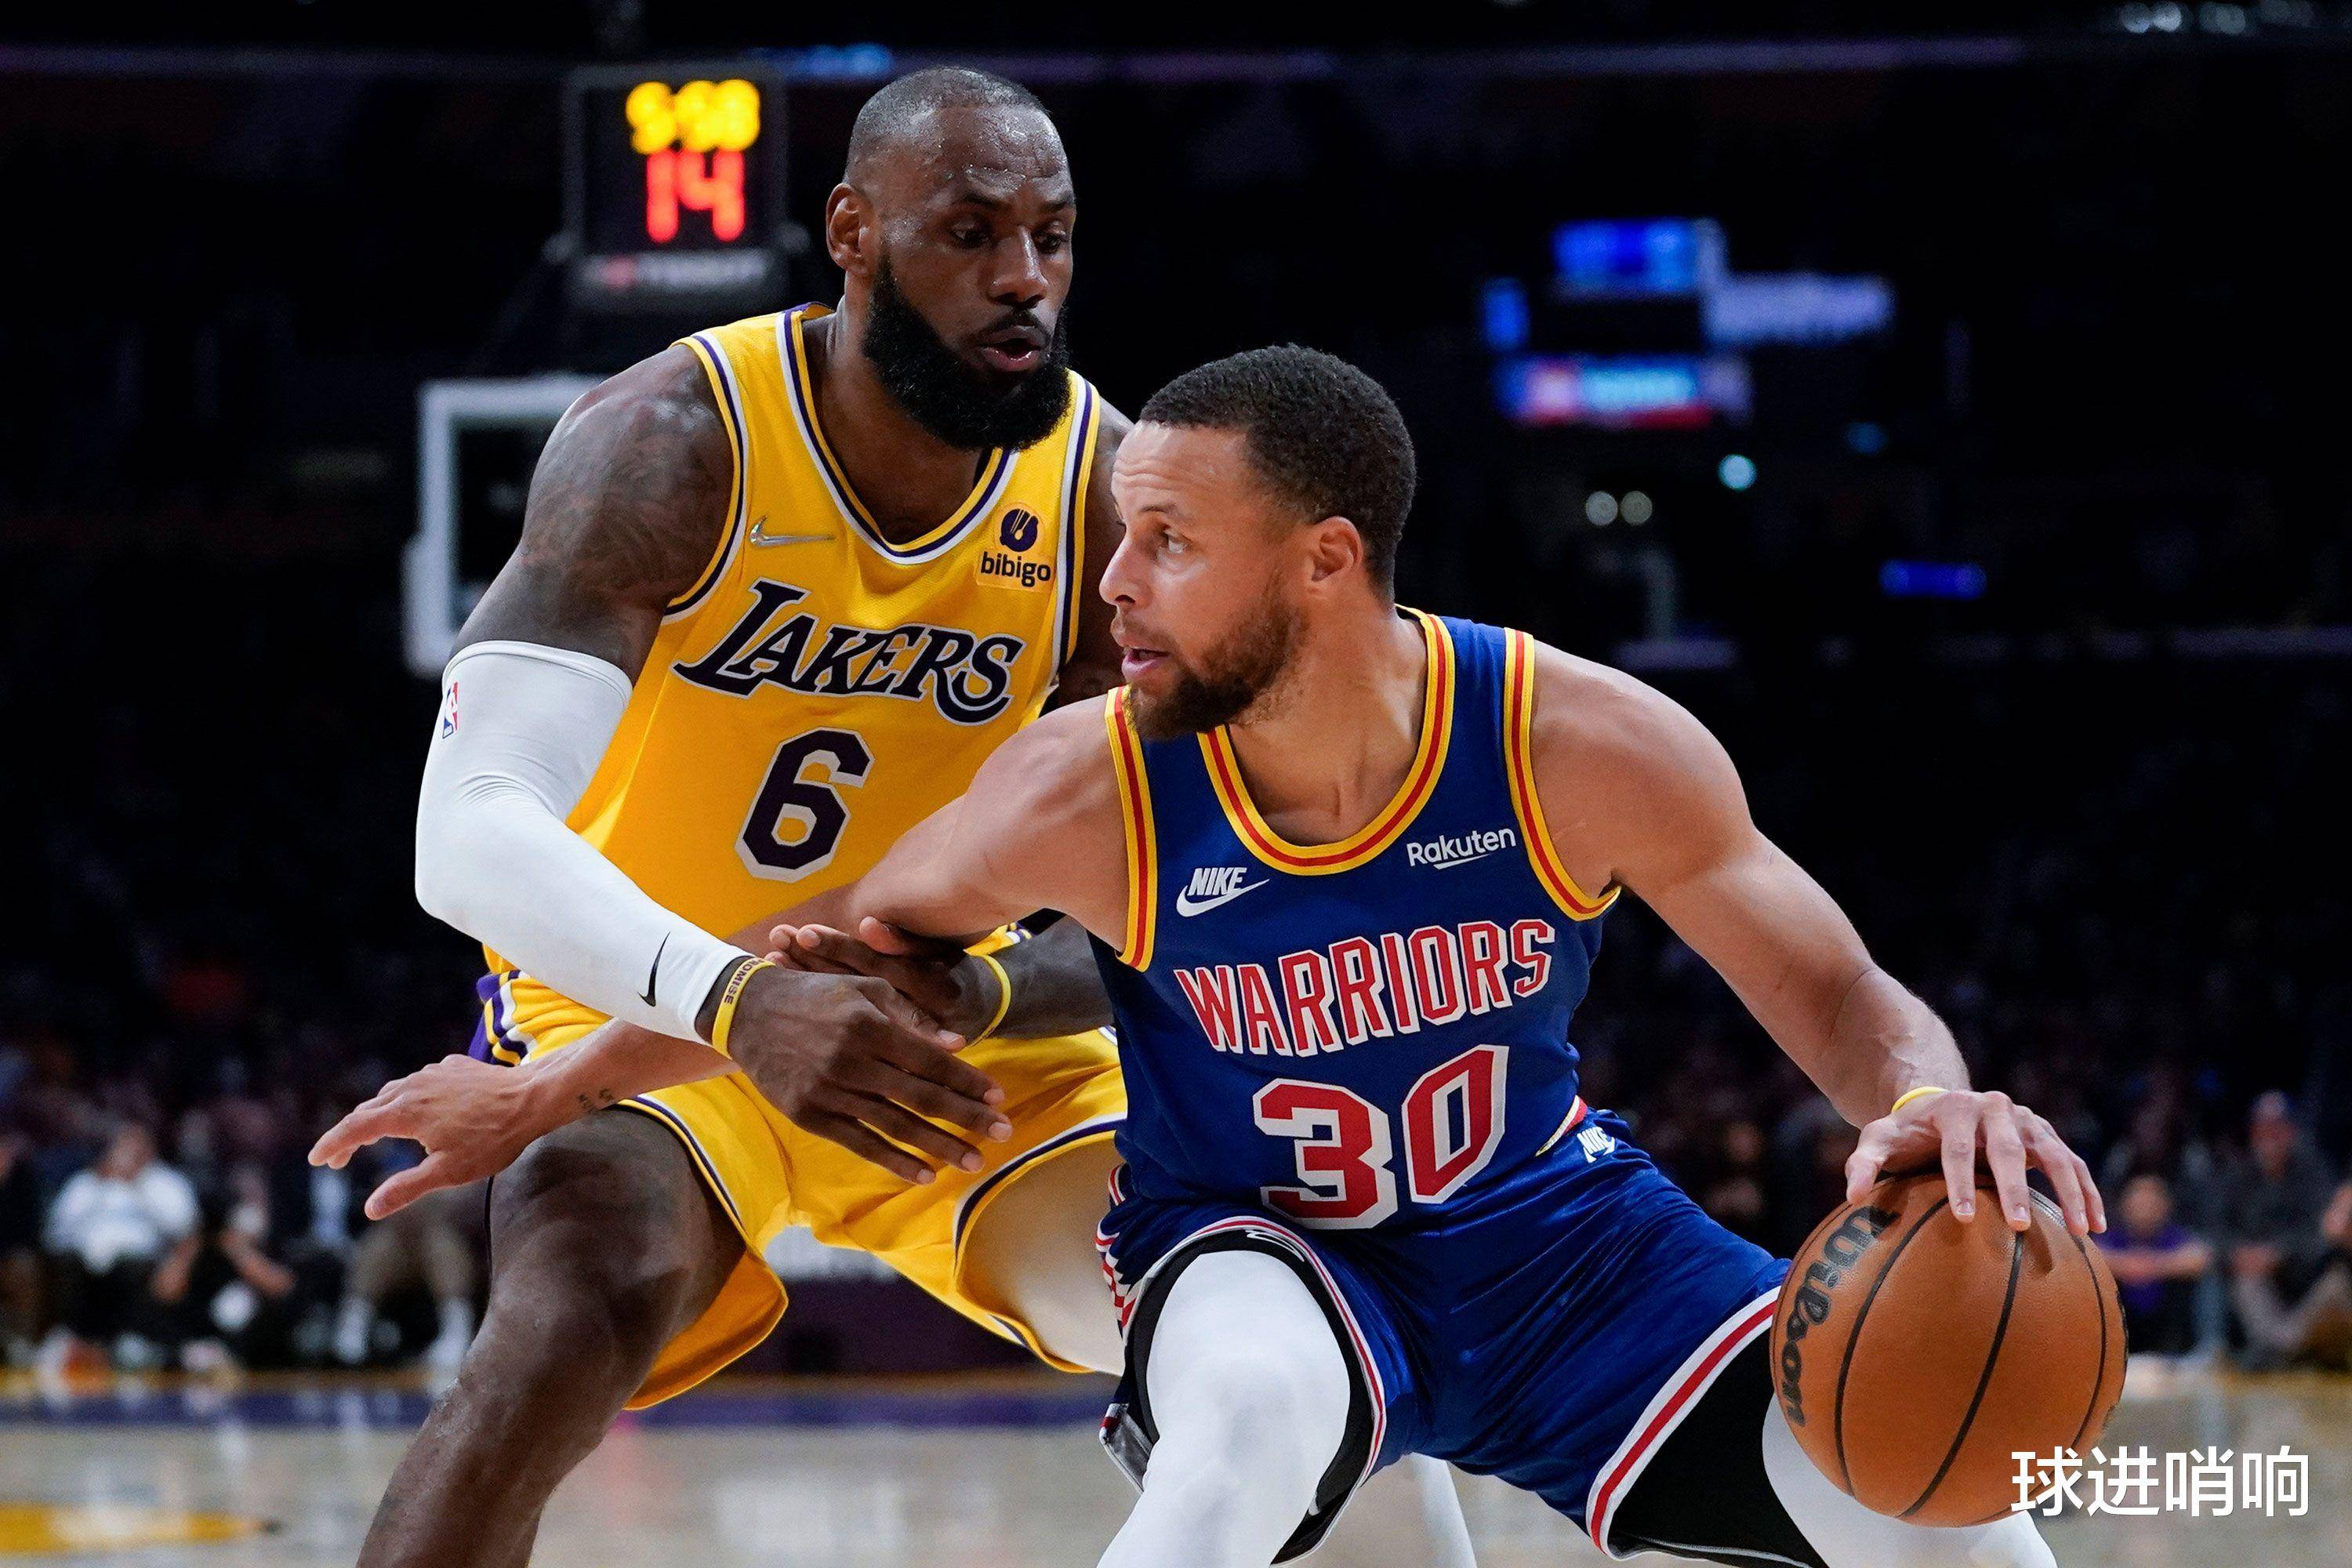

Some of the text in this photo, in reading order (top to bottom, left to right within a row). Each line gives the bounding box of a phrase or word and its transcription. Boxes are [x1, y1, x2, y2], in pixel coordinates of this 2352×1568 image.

[646, 147, 745, 242] 14
[981, 551, 1051, 587] bibigo
[670, 577, 1026, 726] LAKERS
[734, 727, 875, 884] 6
[1406, 828, 1517, 868] Rakuten
[1187, 866, 1247, 896] NIKE
[1173, 919, 1555, 1057] WARRIORS
[1252, 1044, 1510, 1229] 30
